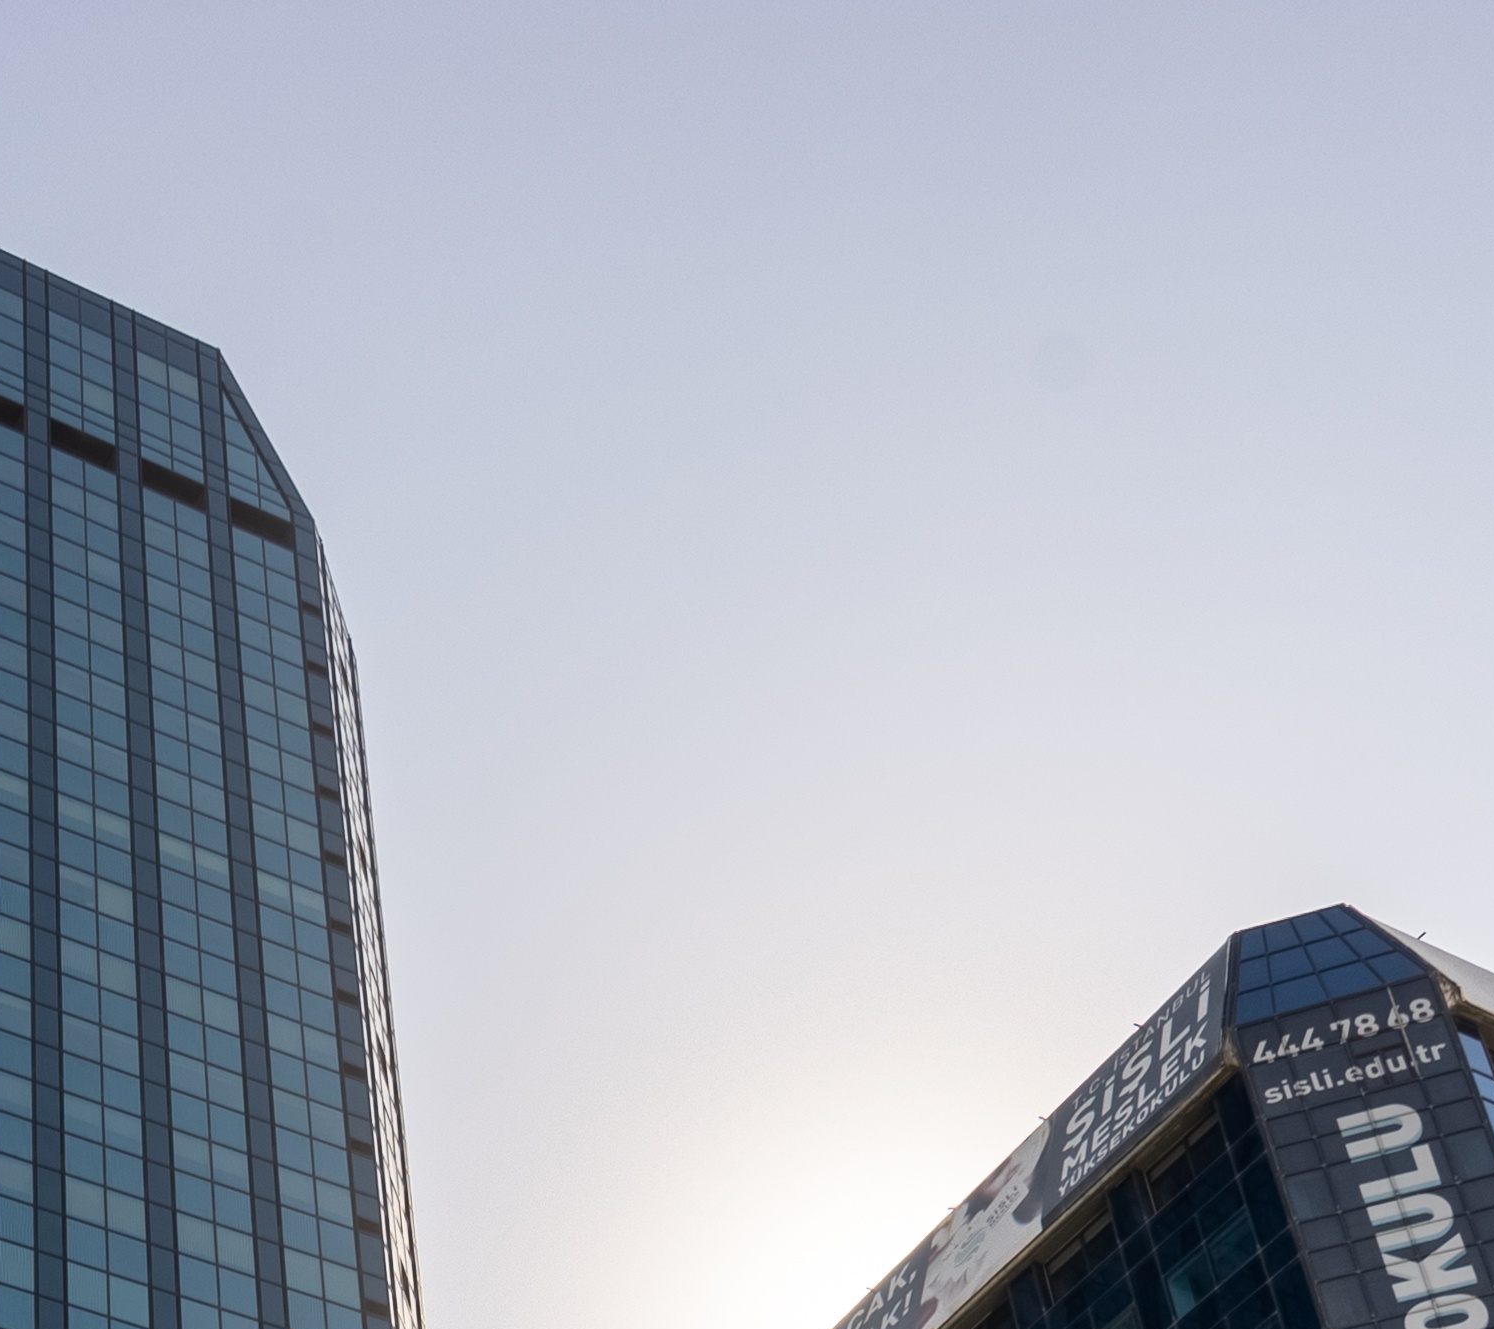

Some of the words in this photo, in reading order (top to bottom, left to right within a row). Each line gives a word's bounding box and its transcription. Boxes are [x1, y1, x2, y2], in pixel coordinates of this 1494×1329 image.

[1062, 980, 1211, 1153] ŞİŞLİ
[1113, 971, 1211, 1072] İSTANBUL
[1253, 1027, 1324, 1063] 444
[1330, 1013, 1379, 1044] 78
[1387, 998, 1435, 1029] 68
[1264, 1042, 1446, 1104] sisli.edu.tr
[1058, 1053, 1205, 1197] YÜKSEKOKULU
[1060, 1020, 1209, 1182] MESLEK
